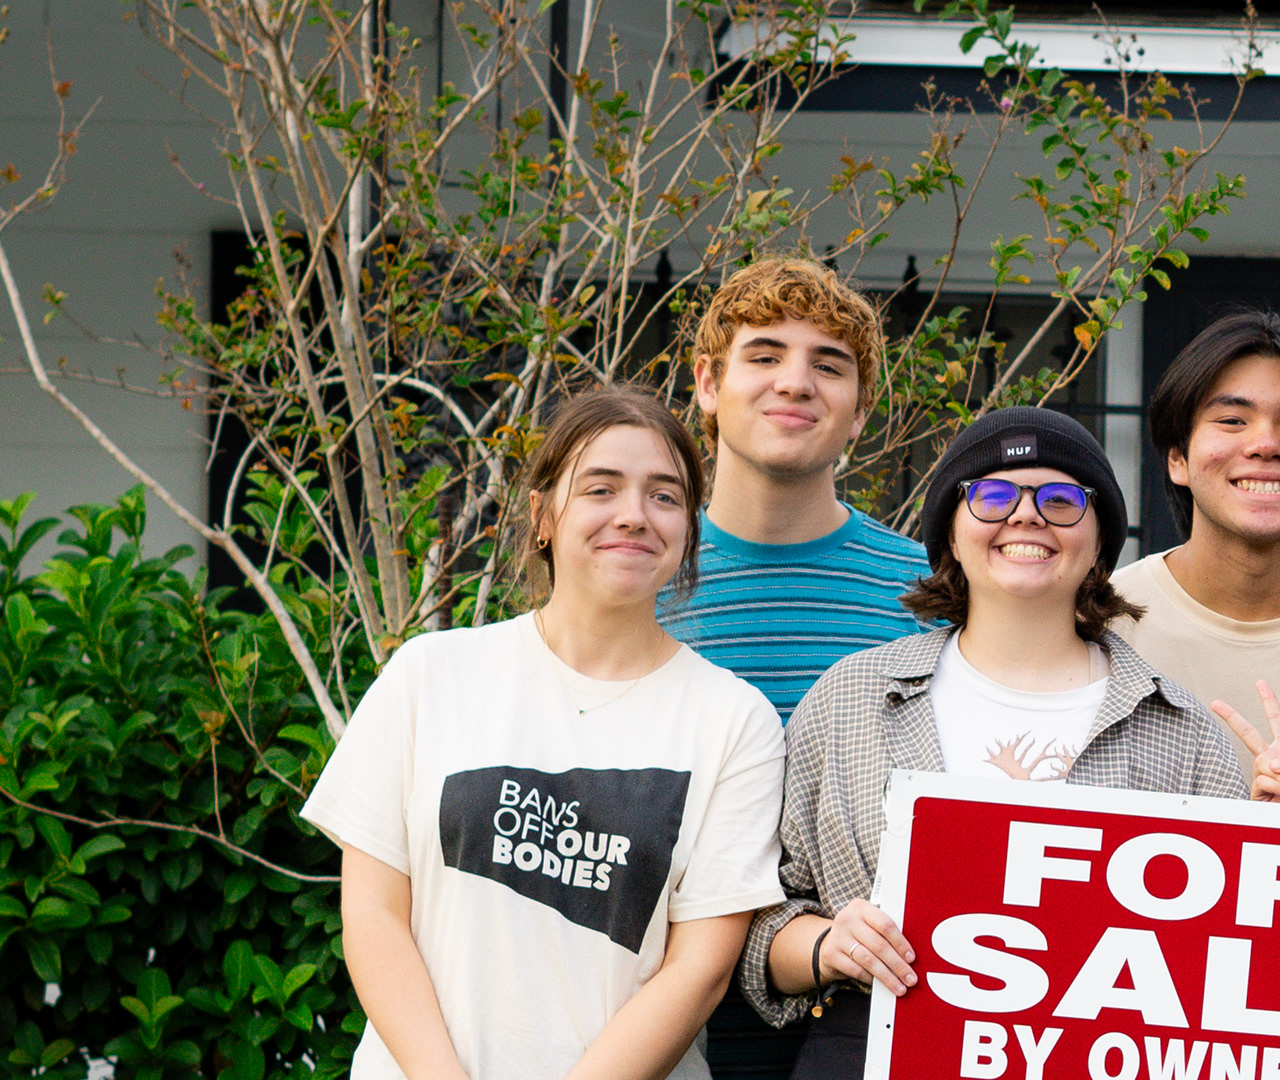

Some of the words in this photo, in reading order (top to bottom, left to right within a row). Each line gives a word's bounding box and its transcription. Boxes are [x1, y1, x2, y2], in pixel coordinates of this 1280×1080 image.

[1006, 446, 1032, 456] HUF
[498, 779, 581, 828] BANS
[492, 834, 613, 892] BODIES
[493, 807, 555, 846] OFF
[555, 829, 631, 866] OUR
